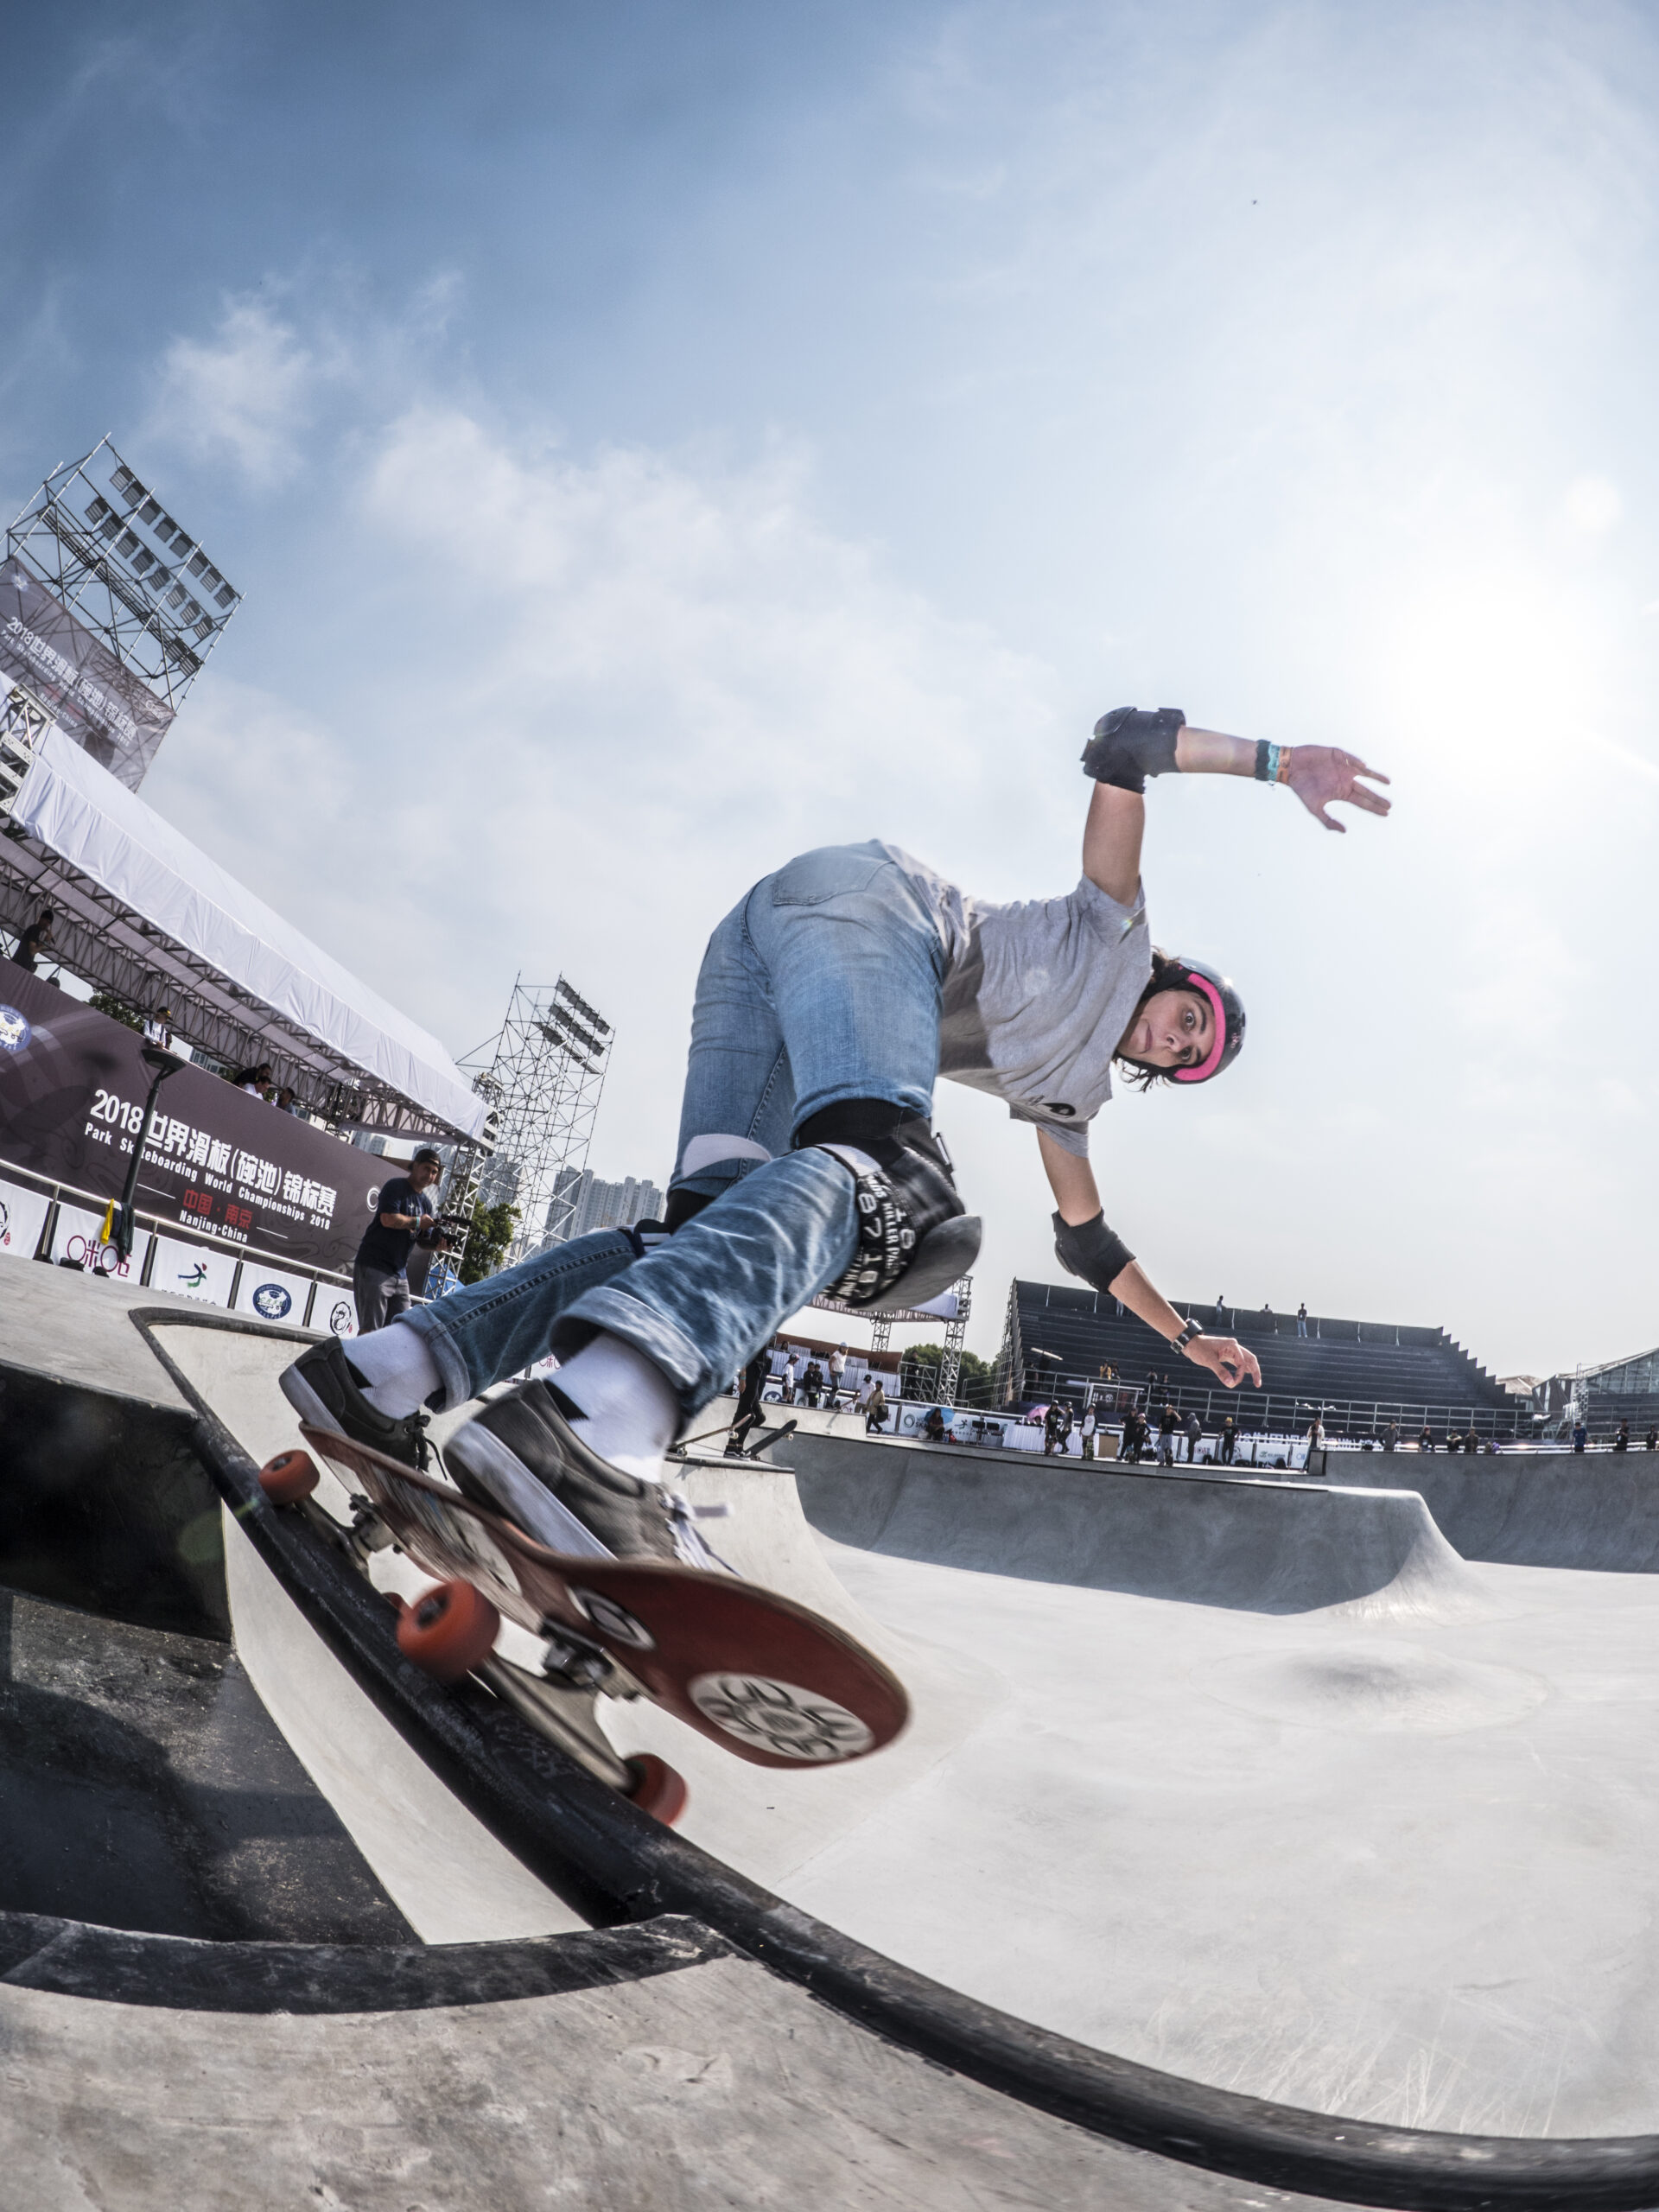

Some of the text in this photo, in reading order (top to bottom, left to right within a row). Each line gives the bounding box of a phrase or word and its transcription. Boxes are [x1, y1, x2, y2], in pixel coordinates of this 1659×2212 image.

[85, 1122, 331, 1230] Park Skteboarding World Championships 2018
